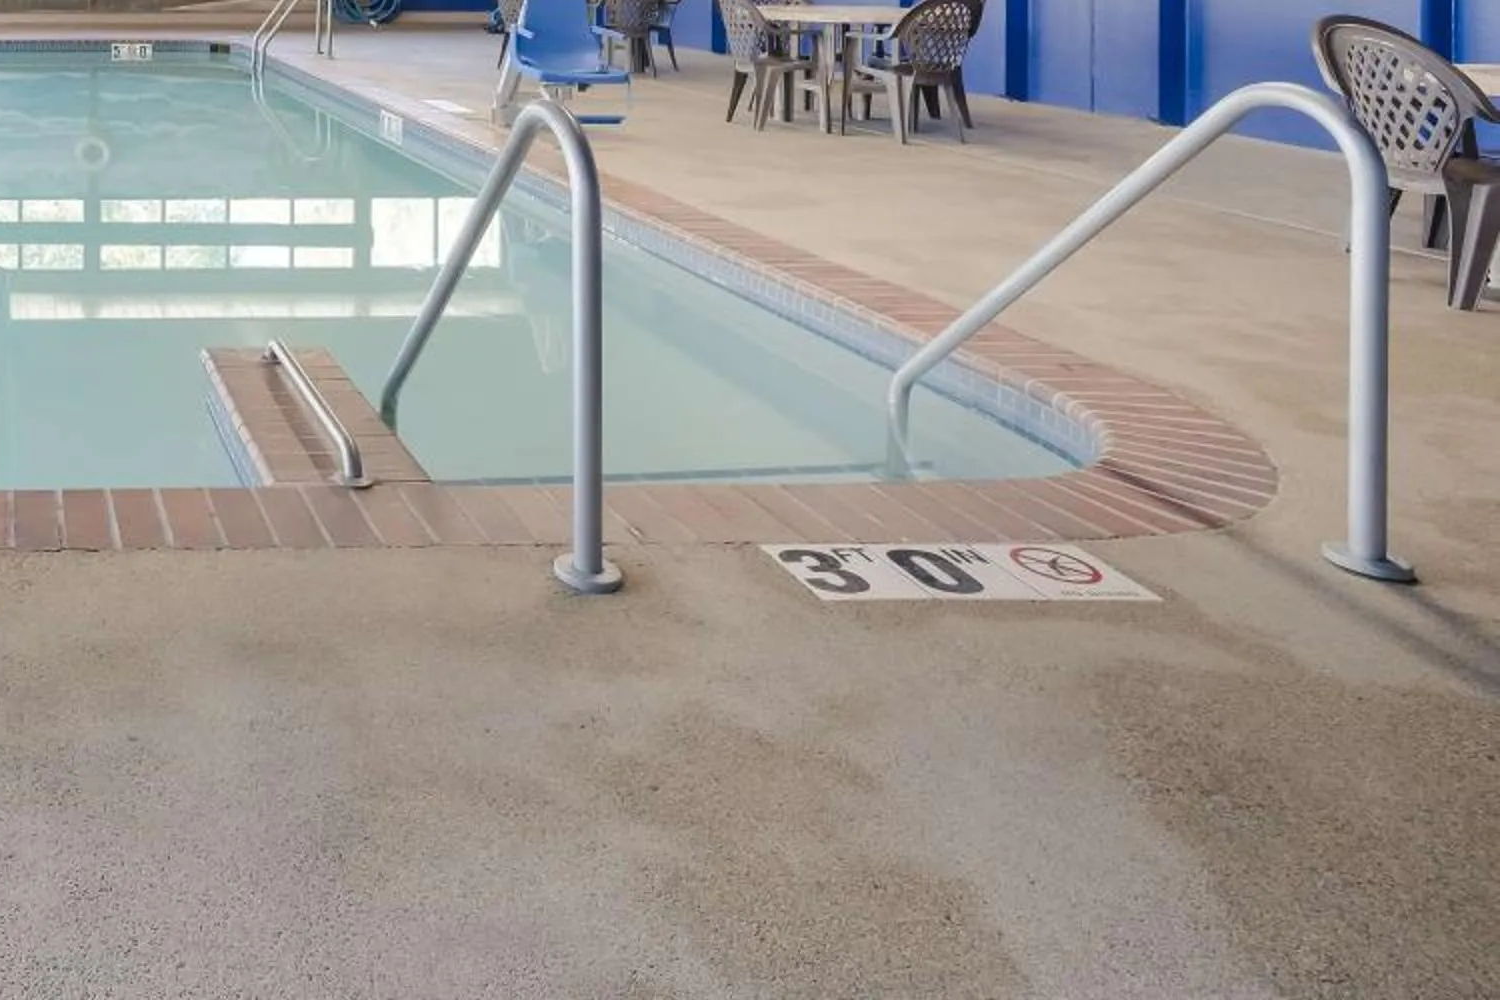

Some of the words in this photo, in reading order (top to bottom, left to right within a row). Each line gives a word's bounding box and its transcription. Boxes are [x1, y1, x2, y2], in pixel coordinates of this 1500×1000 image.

[779, 549, 871, 594] 3
[831, 547, 874, 563] FT
[886, 549, 985, 595] 0
[938, 547, 991, 565] IN
